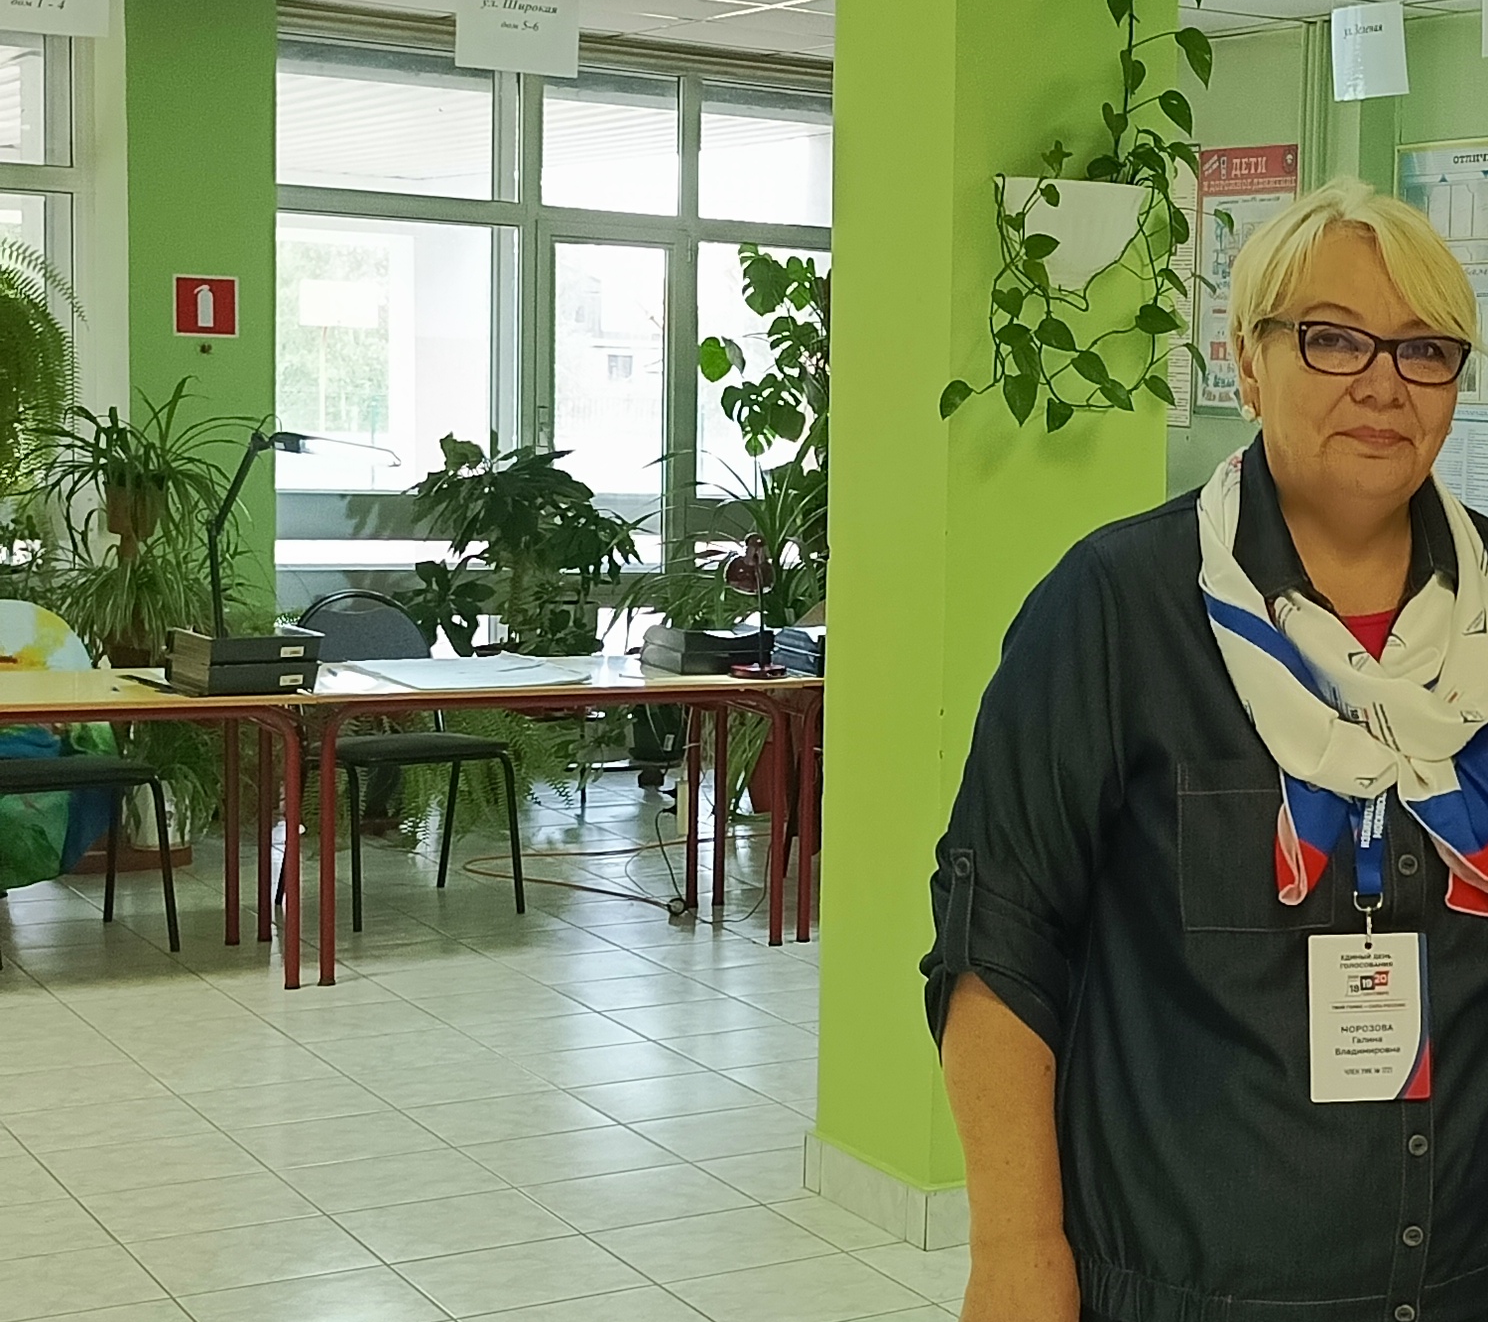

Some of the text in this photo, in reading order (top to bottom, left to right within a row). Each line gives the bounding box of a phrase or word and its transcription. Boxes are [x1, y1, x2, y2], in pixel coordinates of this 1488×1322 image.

[480, 0, 499, 9] ул.
[500, 21, 519, 30] дом
[1231, 156, 1267, 179] ДЕТИ
[1340, 961, 1393, 969] ГОЛОСОВАНИЯ
[1341, 1024, 1394, 1034] МОРОЗОВА
[1352, 1036, 1383, 1044] Галина
[1335, 1047, 1401, 1056] Владимировна
